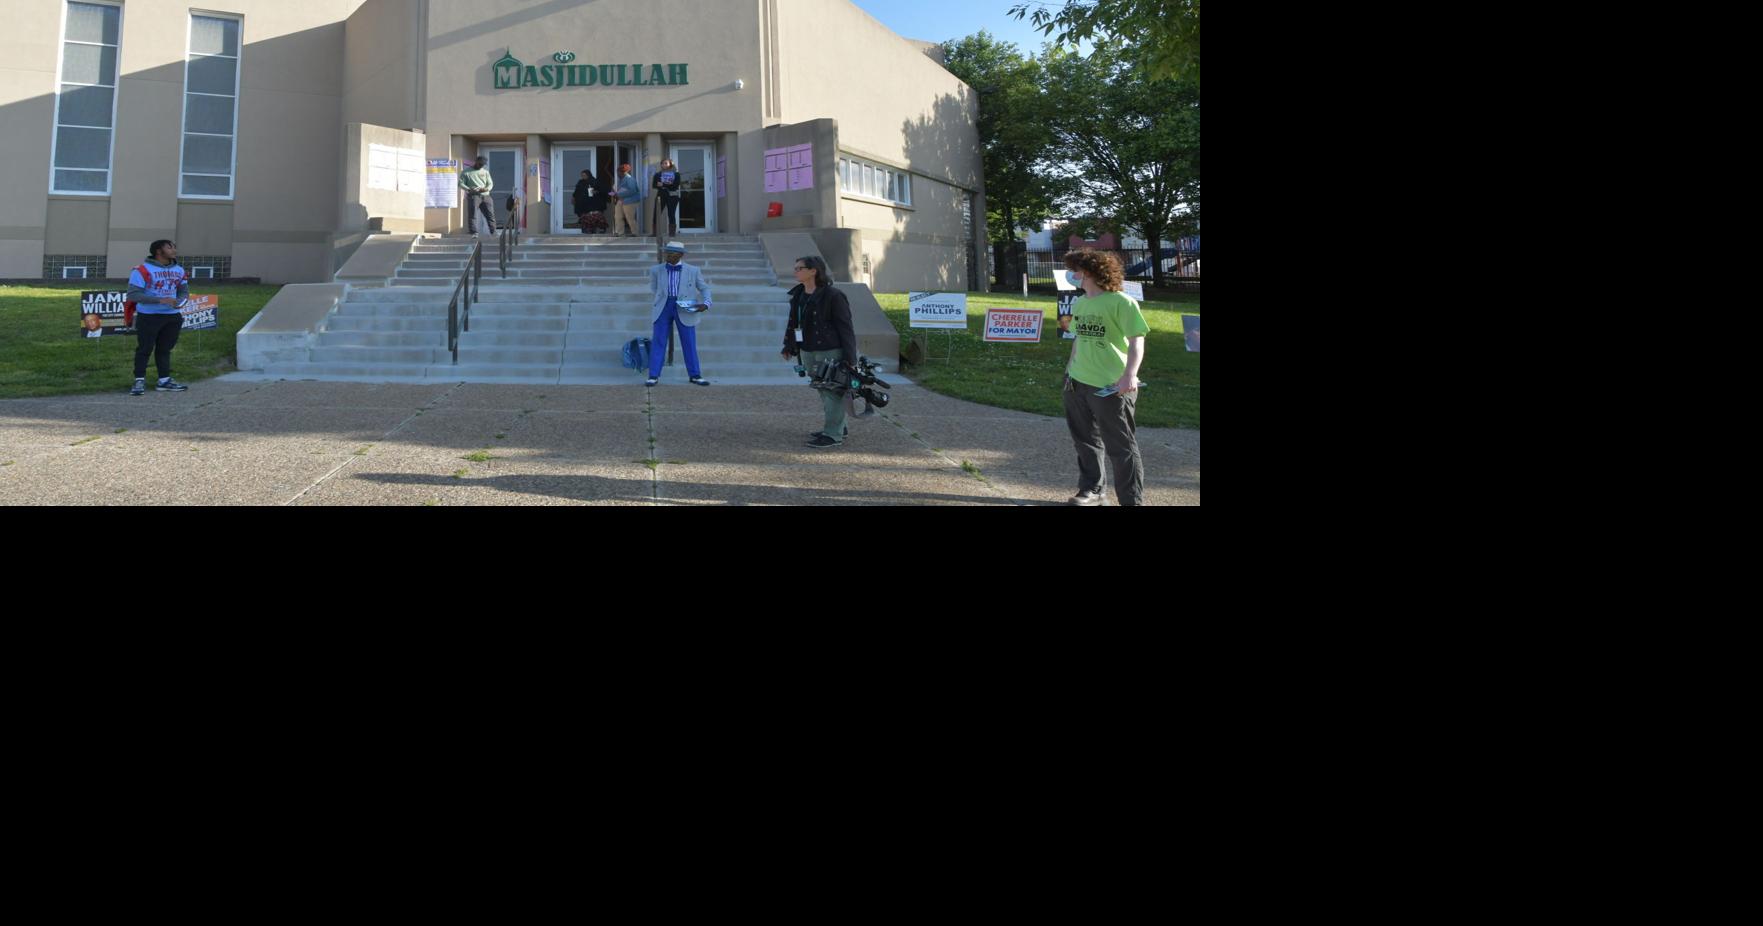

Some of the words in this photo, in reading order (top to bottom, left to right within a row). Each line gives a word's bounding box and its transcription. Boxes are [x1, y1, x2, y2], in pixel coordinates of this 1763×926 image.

[494, 63, 689, 89] MASJIDULLAH
[82, 293, 127, 303] JAM
[185, 295, 208, 306] ELLE
[82, 302, 125, 314] WILLIA
[914, 307, 962, 315] PHILLIPS
[181, 315, 215, 328] ILLIPS
[991, 313, 1038, 322] CHERELLE
[994, 320, 1033, 328] PARKER
[1005, 327, 1037, 335] MAYOR
